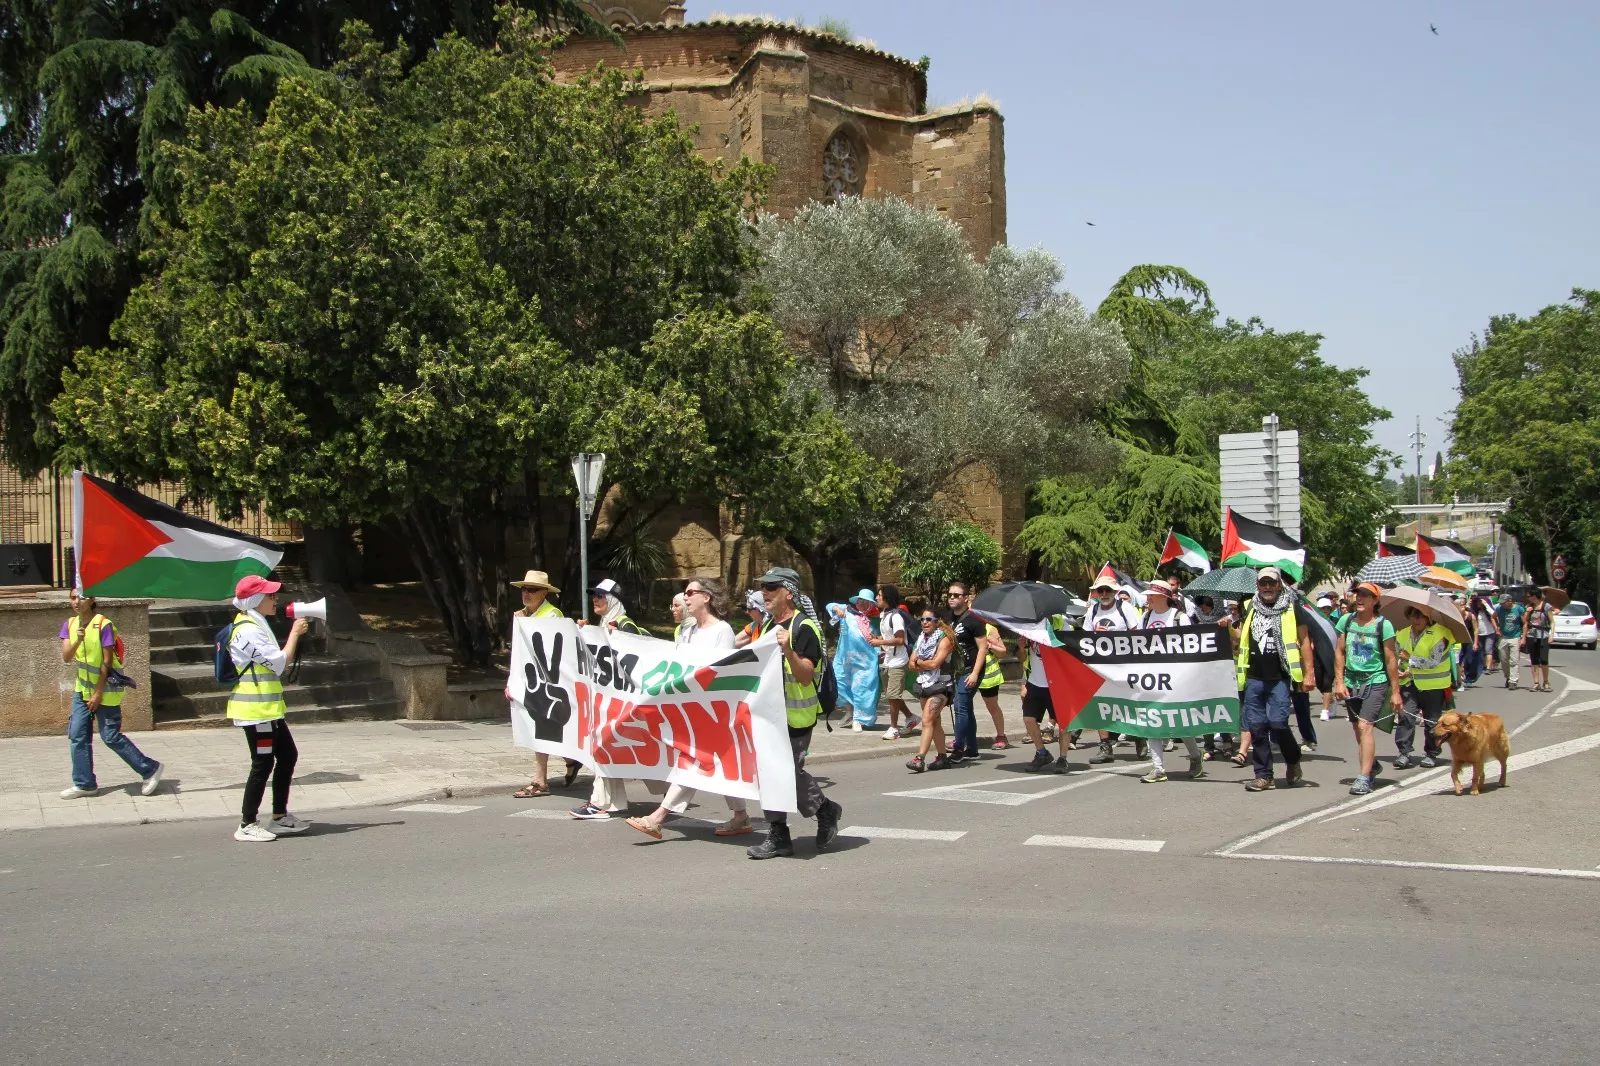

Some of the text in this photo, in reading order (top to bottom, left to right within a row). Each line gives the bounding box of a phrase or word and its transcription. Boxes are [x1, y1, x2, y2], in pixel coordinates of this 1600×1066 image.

[1079, 633, 1217, 656] SOBRARBE
[1127, 673, 1172, 690] POR
[1098, 703, 1233, 728] PALESTINA
[575, 682, 760, 790] PLESTINA
